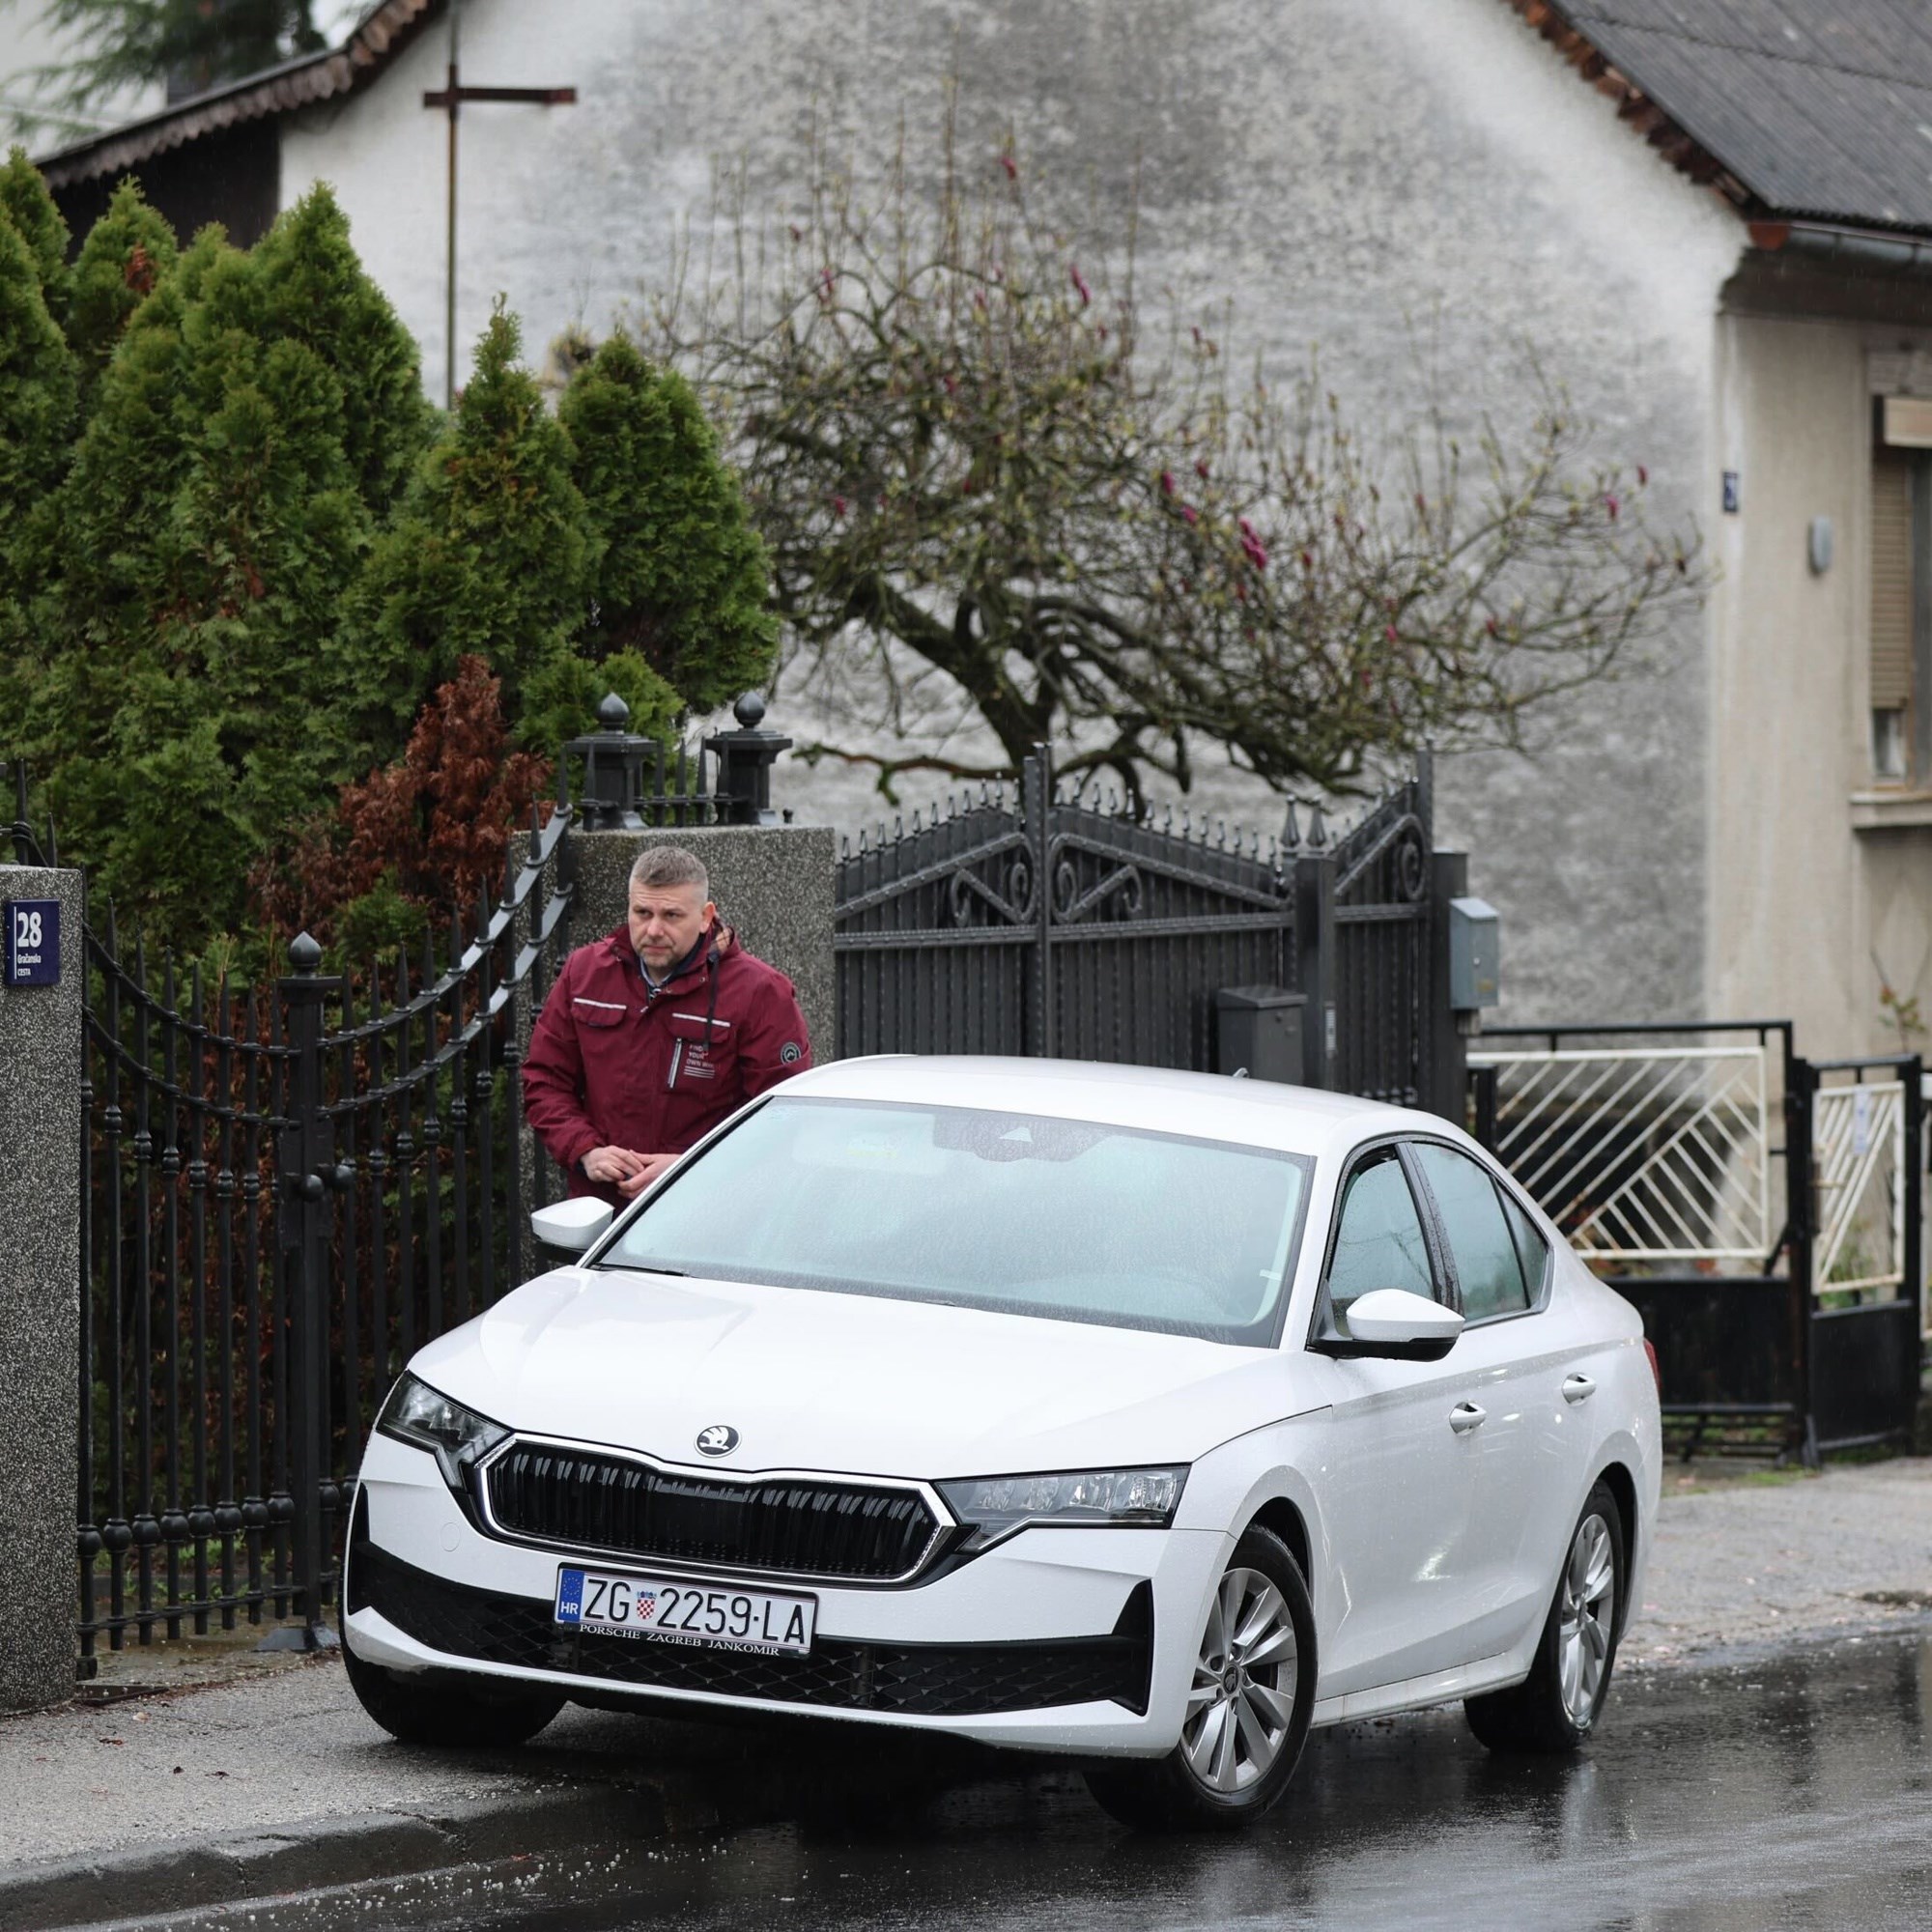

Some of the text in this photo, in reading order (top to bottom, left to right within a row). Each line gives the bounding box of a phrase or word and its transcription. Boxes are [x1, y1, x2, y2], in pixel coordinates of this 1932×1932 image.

[17, 911, 43, 948] 28
[560, 1600, 579, 1616] HR
[584, 1578, 632, 1622] ZG
[580, 1624, 781, 1657] PORSCHE ZAGREB JANKOMIR
